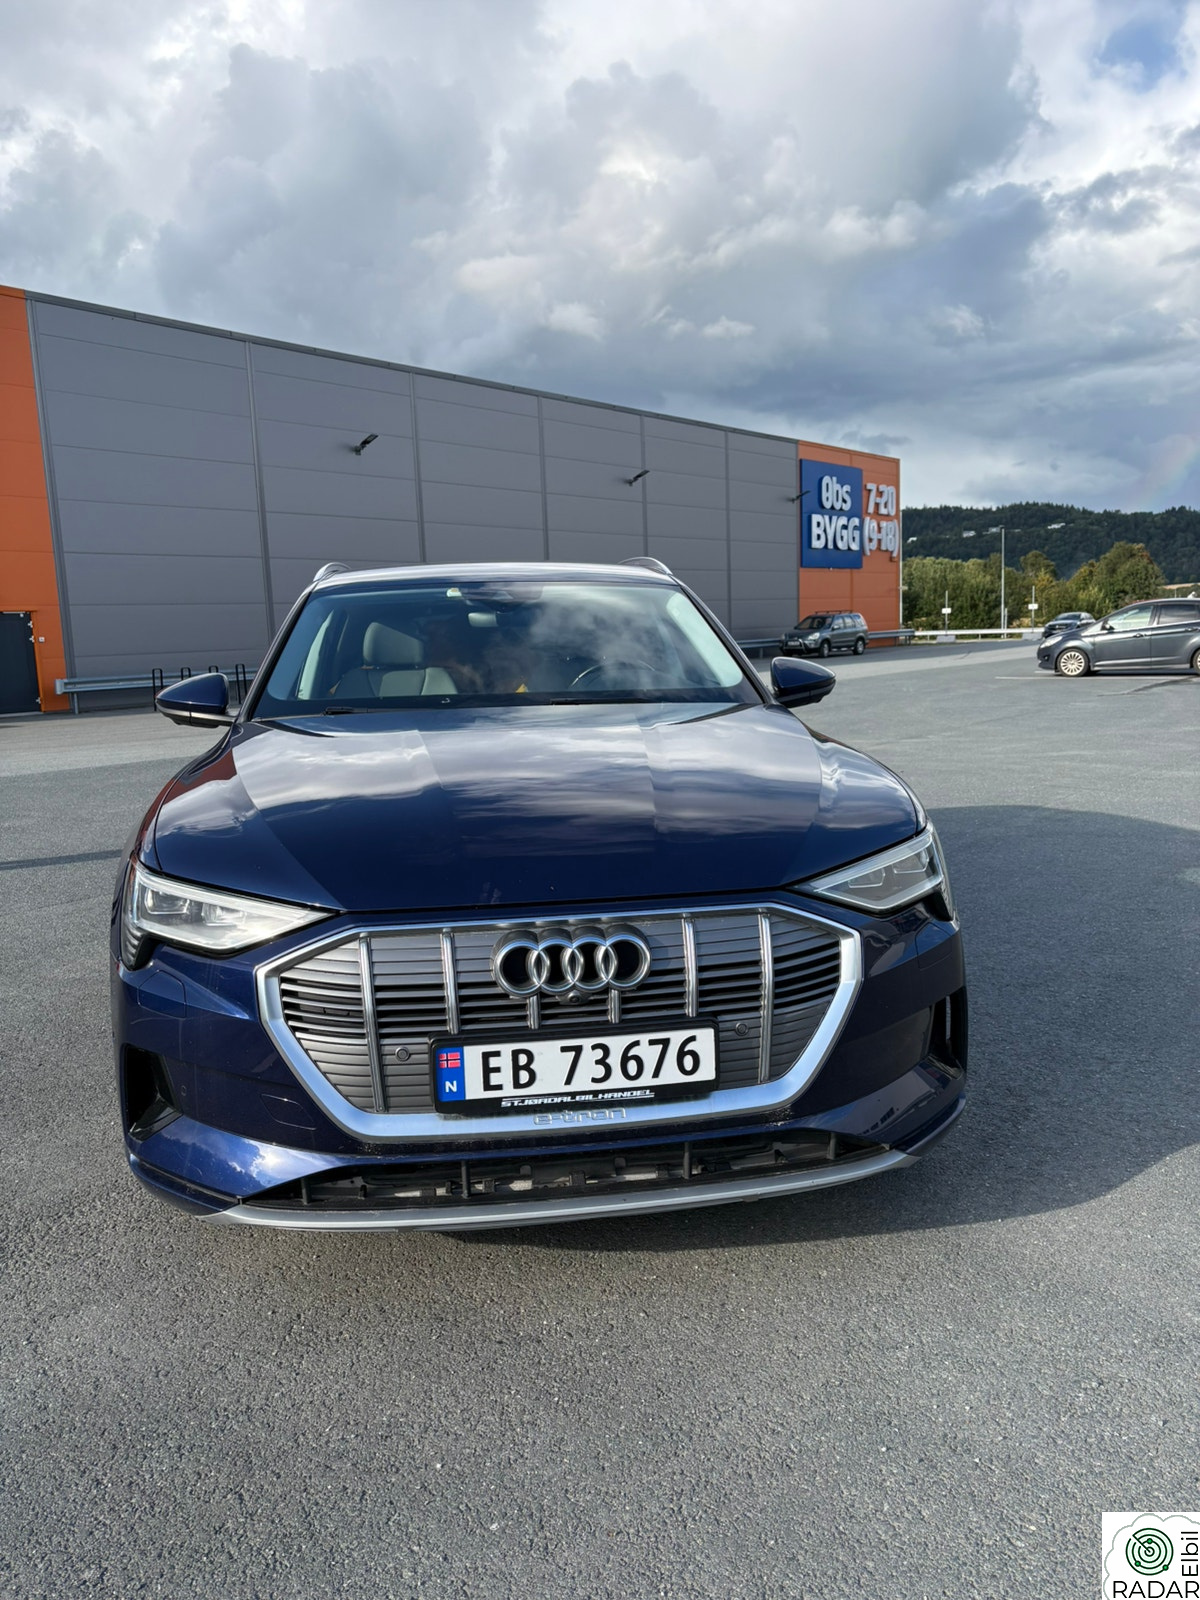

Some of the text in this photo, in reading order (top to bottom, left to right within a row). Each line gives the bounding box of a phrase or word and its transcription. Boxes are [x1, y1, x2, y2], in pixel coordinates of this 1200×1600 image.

[866, 483, 896, 516] 7-20
[811, 513, 860, 551] BYGG
[863, 516, 900, 558] (9-18)
[481, 1035, 700, 1092] EB 73676
[445, 1080, 457, 1093] N
[533, 1107, 626, 1126] e-tron
